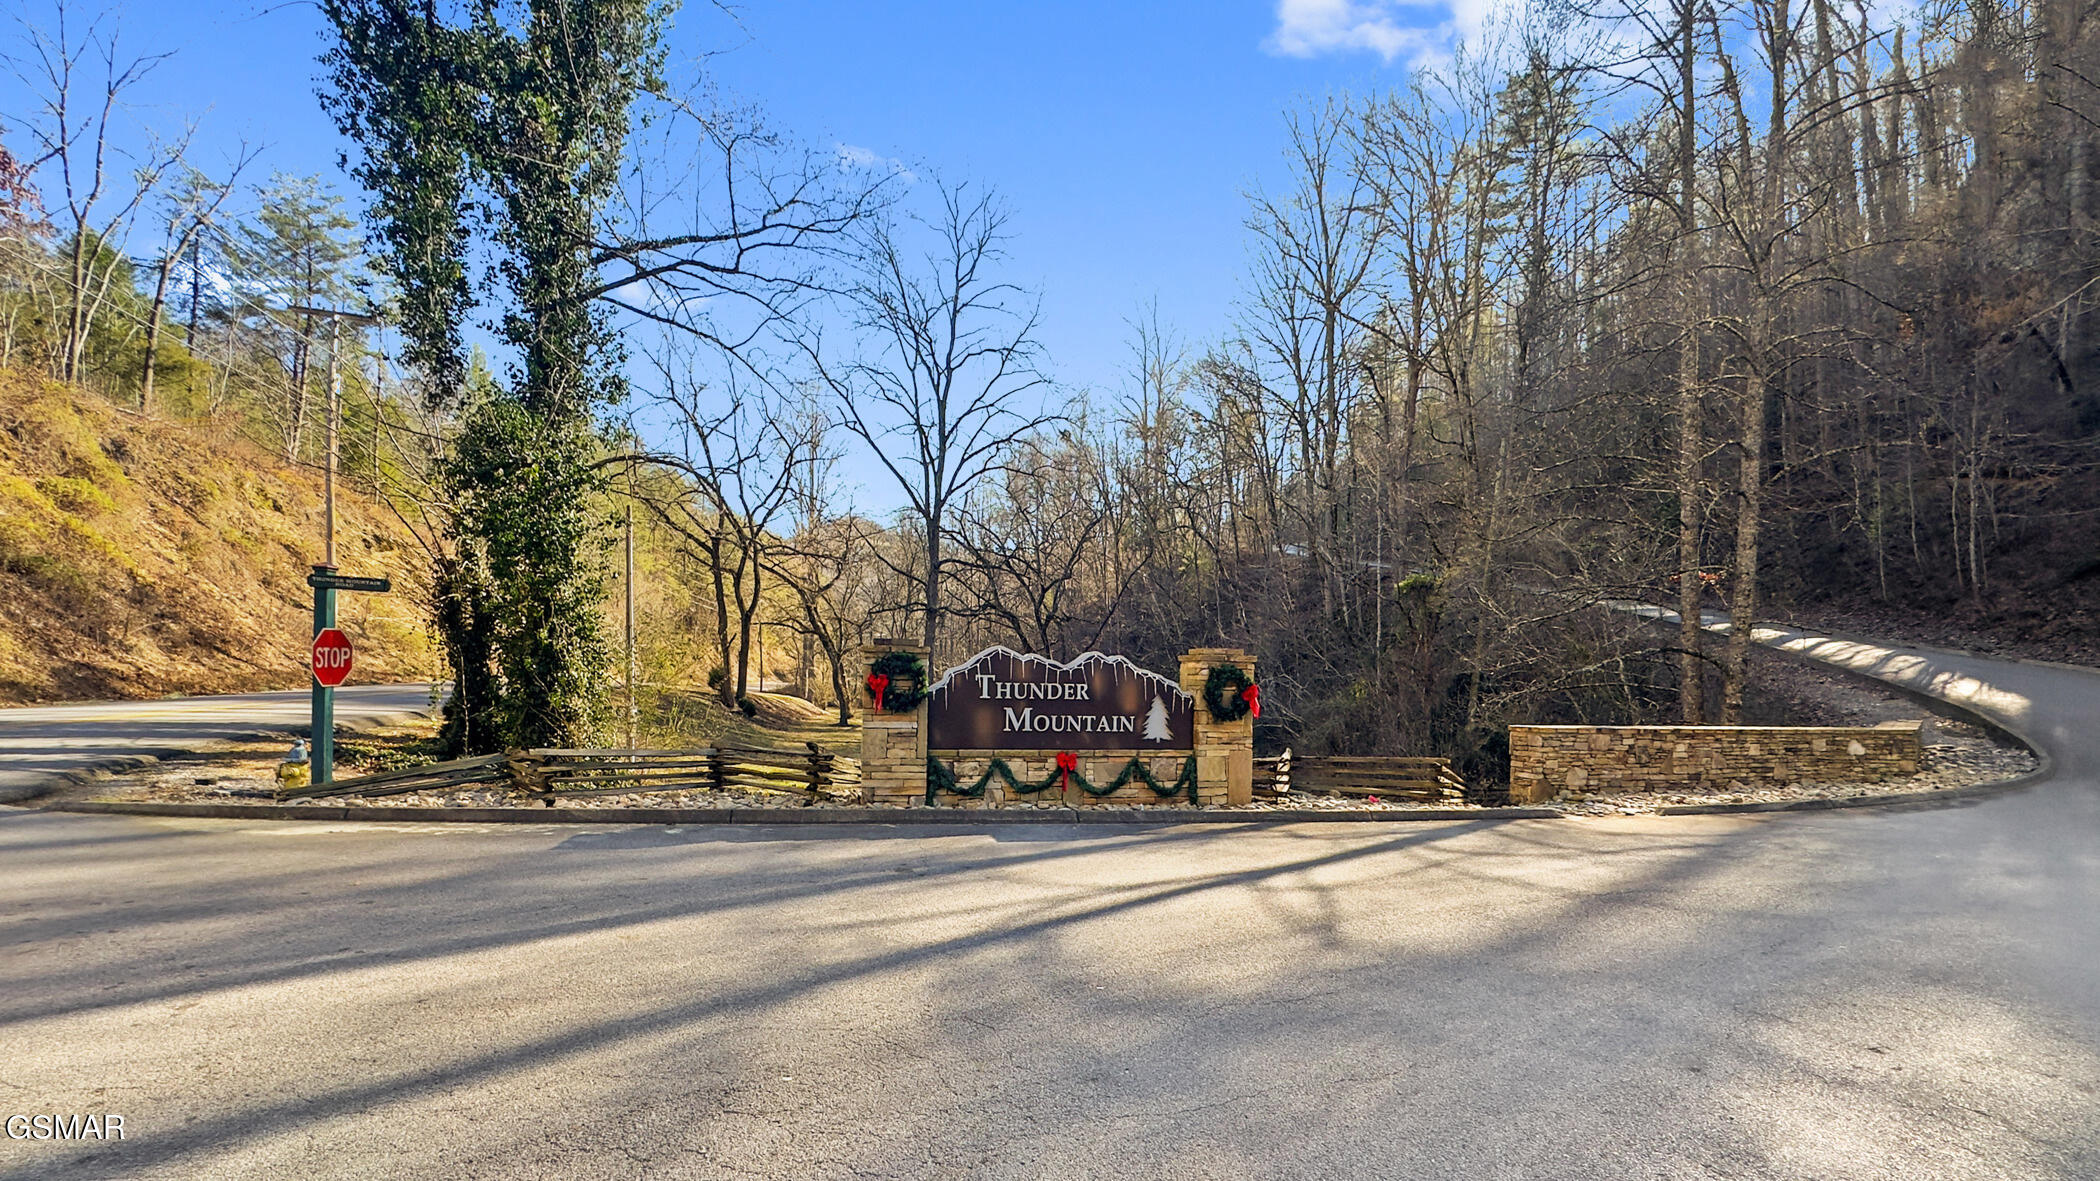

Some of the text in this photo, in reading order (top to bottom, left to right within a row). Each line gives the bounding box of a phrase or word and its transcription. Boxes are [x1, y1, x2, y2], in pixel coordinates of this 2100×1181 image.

[346, 578, 381, 586] MOUNTAIN
[315, 646, 350, 668] STOP
[975, 674, 1090, 700] THUNDER
[1003, 707, 1135, 732] MOUNTAIN
